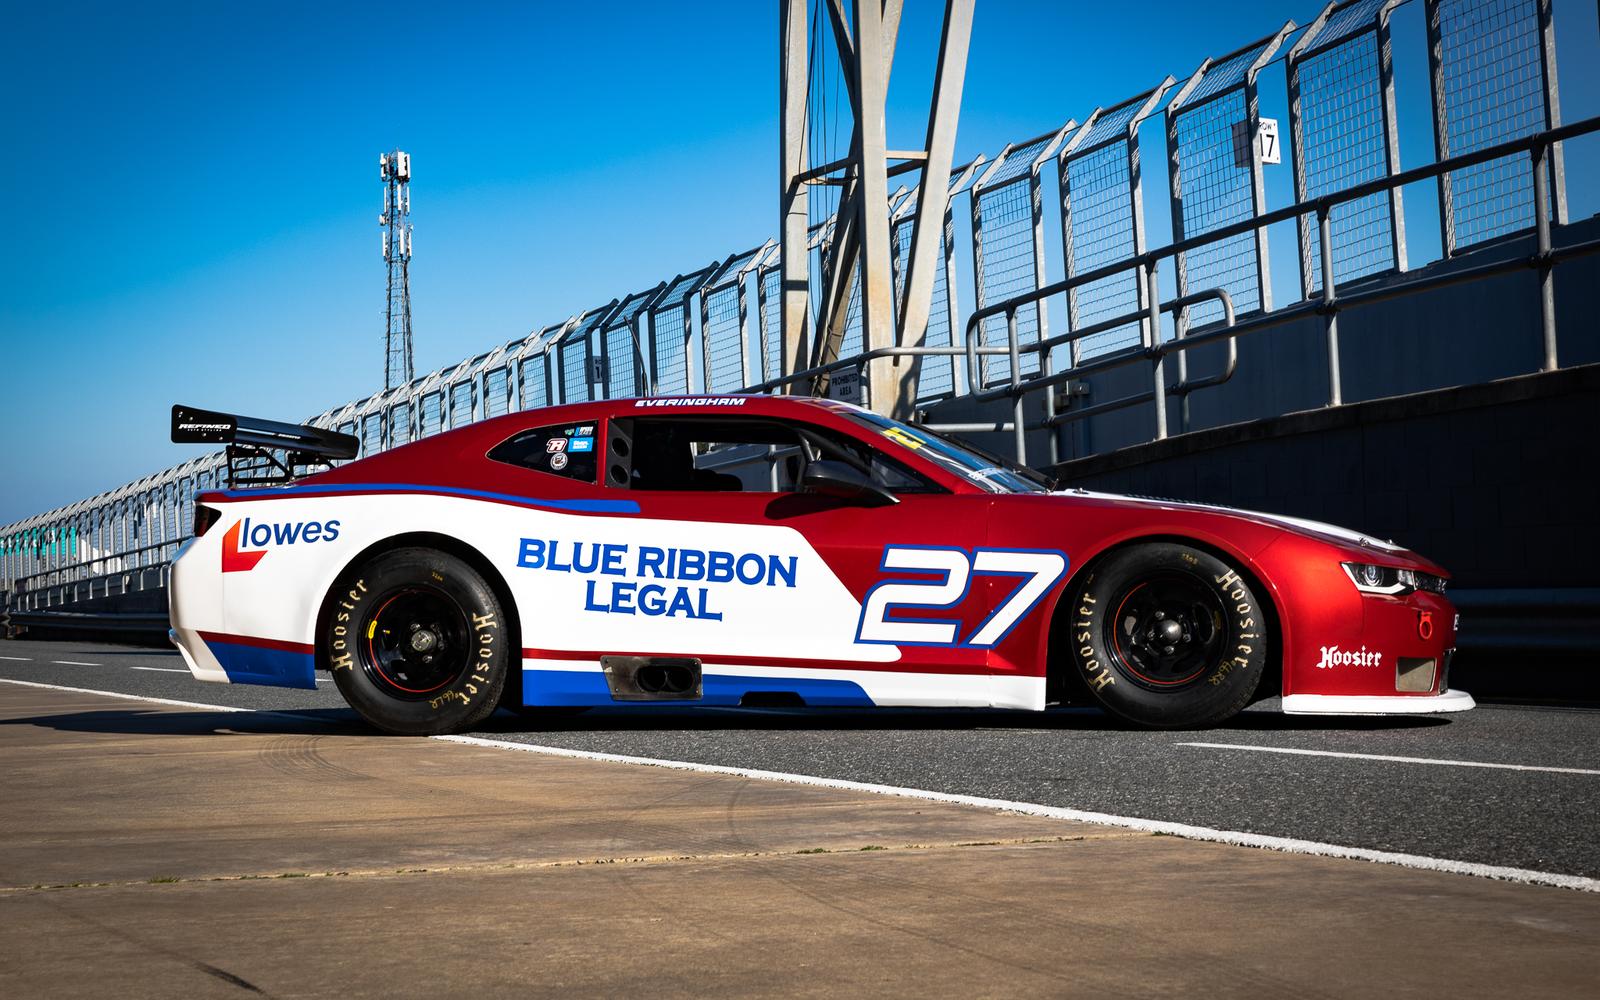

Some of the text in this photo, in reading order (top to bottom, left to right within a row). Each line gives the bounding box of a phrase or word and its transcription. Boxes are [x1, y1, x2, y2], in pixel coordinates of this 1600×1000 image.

[1259, 133, 1275, 157] 17
[831, 373, 858, 386] PROHIBITED
[839, 386, 852, 395] AREA
[634, 397, 746, 407] EVERINGHAM
[242, 517, 341, 548] lowes
[516, 537, 799, 588] BLUE RIBBON
[584, 579, 723, 622] LEGAL
[853, 543, 1070, 650] 27
[331, 579, 368, 671] Hoosier
[1215, 569, 1259, 668] Hoosier
[458, 611, 498, 706] Hoosier
[1075, 592, 1115, 691] Hoosier
[1316, 645, 1382, 669] Hoosier
